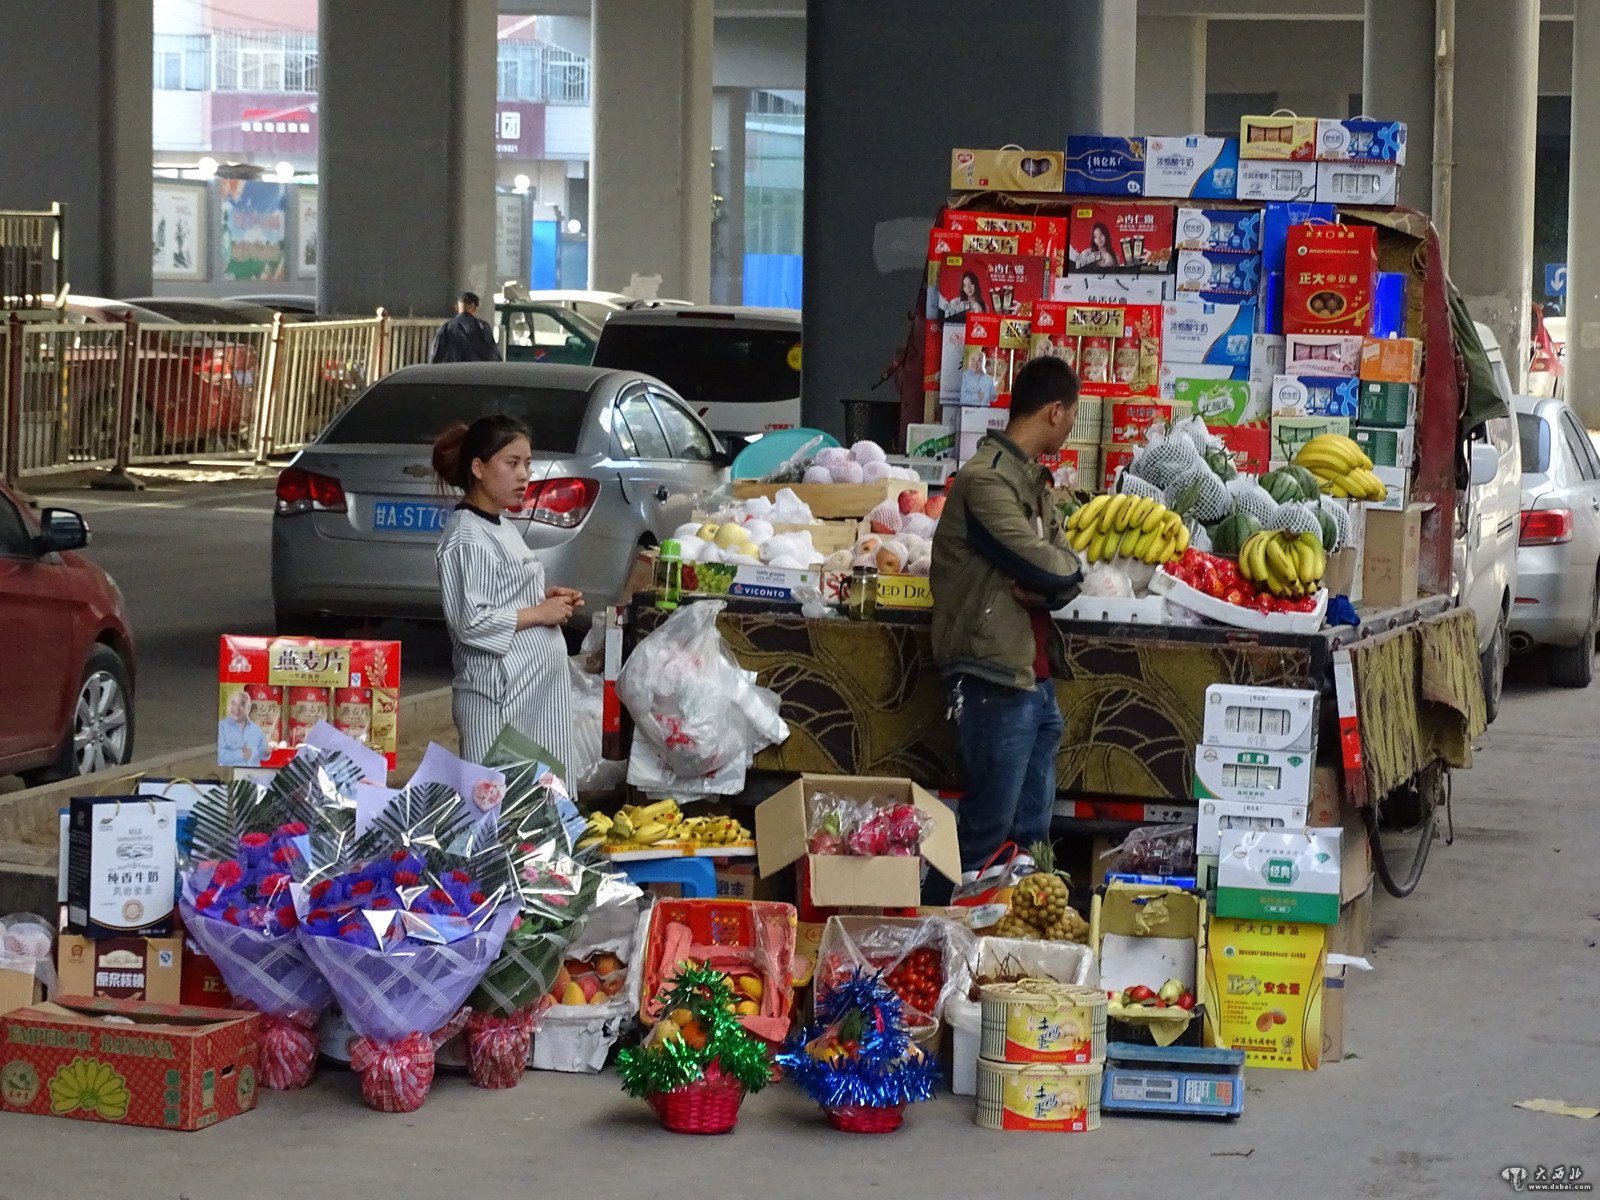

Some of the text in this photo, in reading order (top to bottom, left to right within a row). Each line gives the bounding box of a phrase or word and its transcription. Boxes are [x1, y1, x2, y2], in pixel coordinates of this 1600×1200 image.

[1069, 309, 1121, 326] 燕麦片
[745, 587, 785, 598] VICONTO
[273, 649, 345, 675] 燕麦片
[107, 871, 159, 884] 纯香牛奶
[1269, 864, 1292, 880] 经典
[9, 1024, 175, 1060] EMPEROR BANANA
